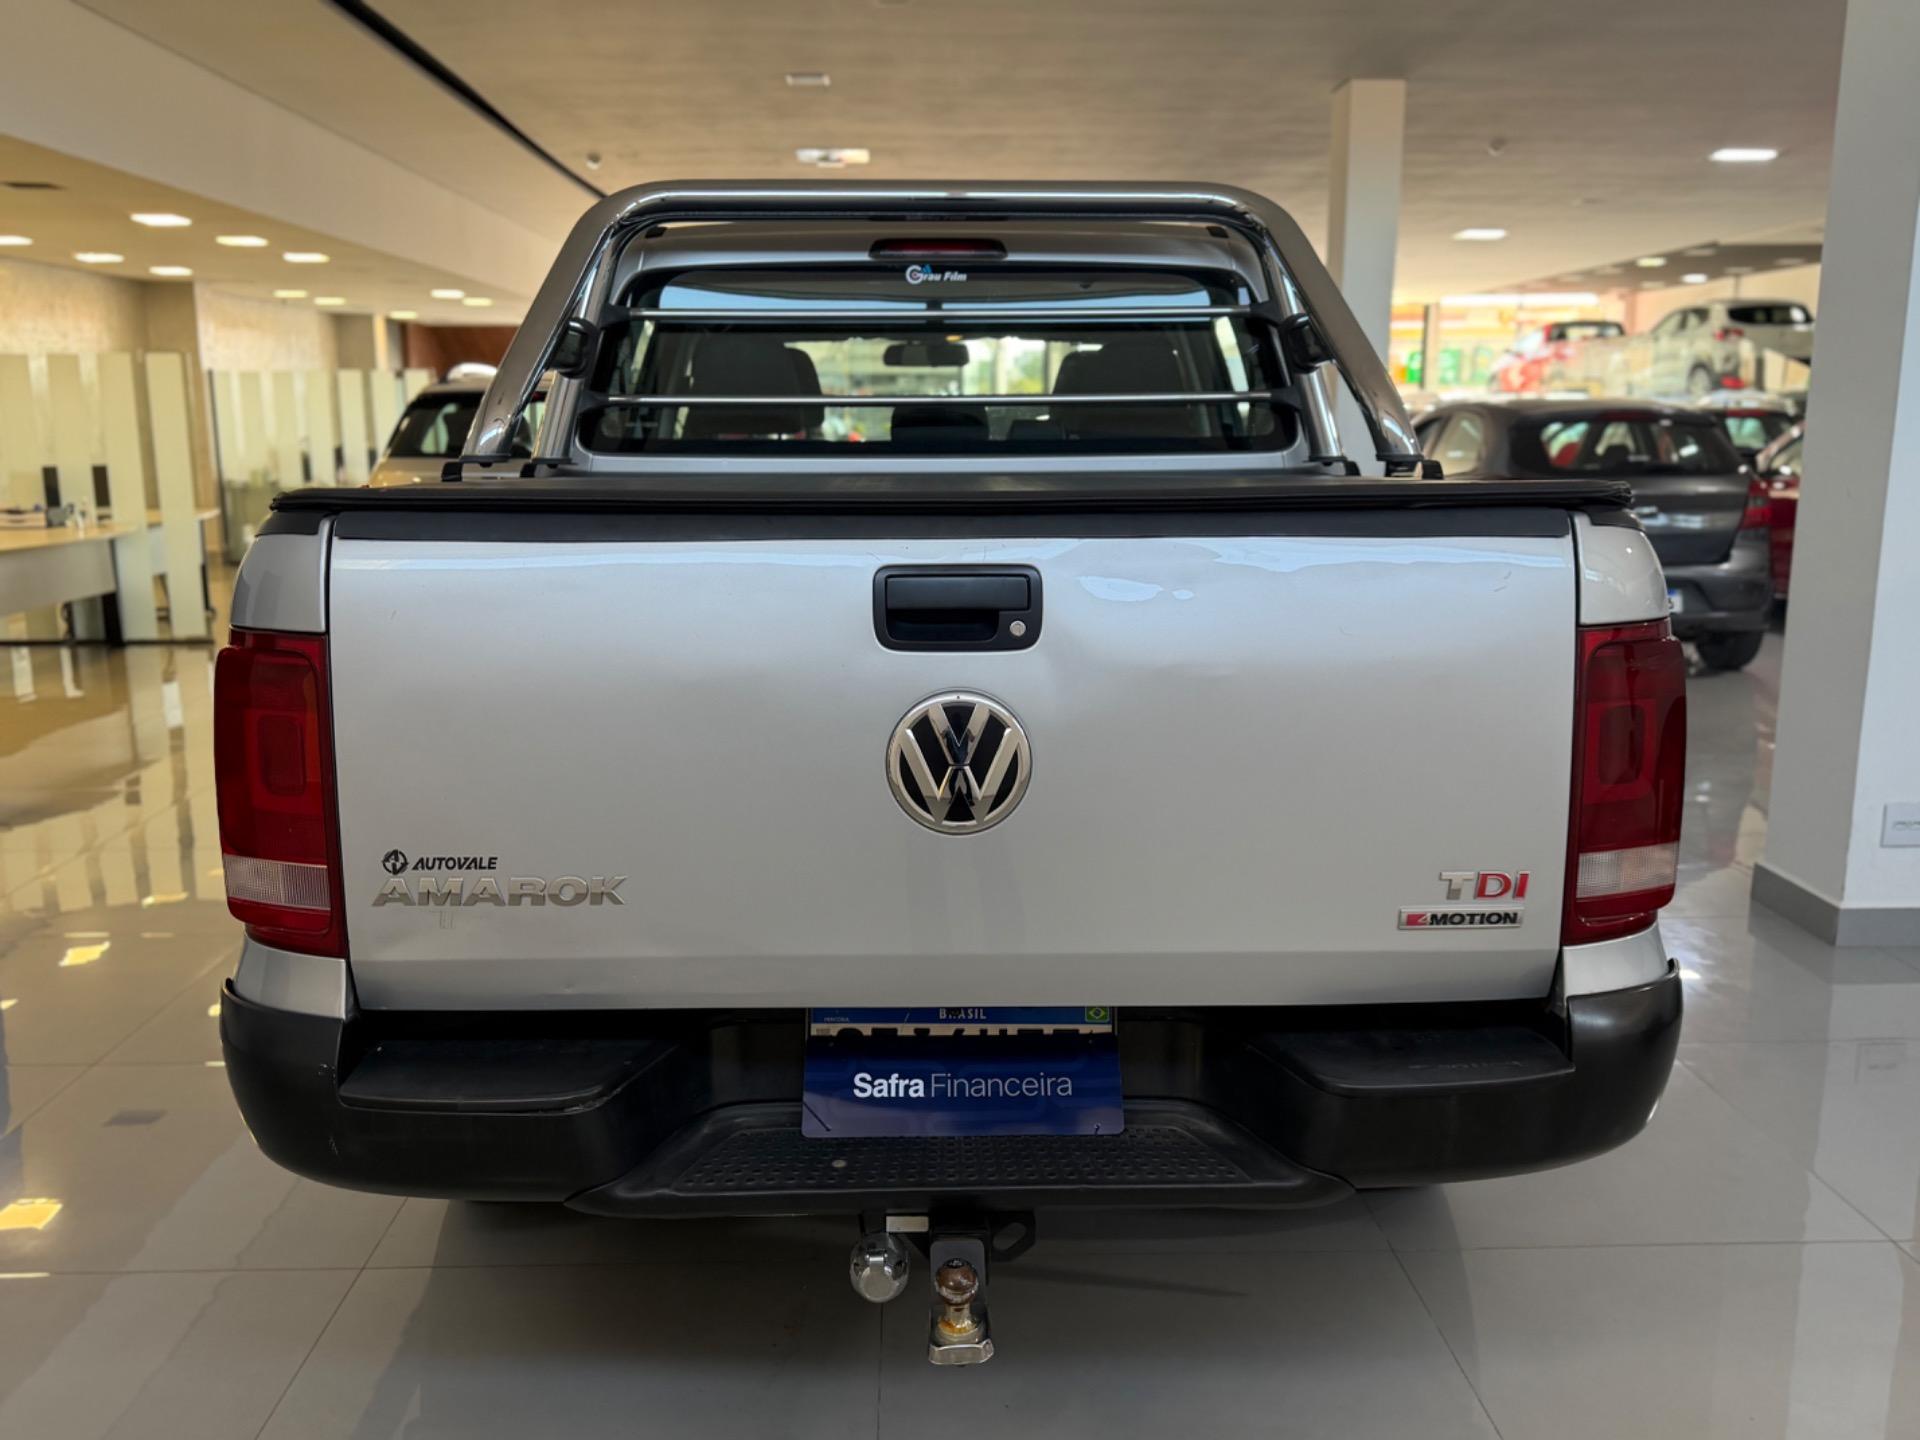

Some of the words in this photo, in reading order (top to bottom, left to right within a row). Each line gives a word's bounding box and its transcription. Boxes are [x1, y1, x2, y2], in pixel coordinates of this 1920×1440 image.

[943, 270, 967, 282] Film
[412, 856, 498, 871] AUTOVALE
[372, 875, 629, 907] AMAROK
[1439, 871, 1531, 901] TDI
[853, 1072, 925, 1099] Safra
[930, 1071, 1073, 1098] Financeira
